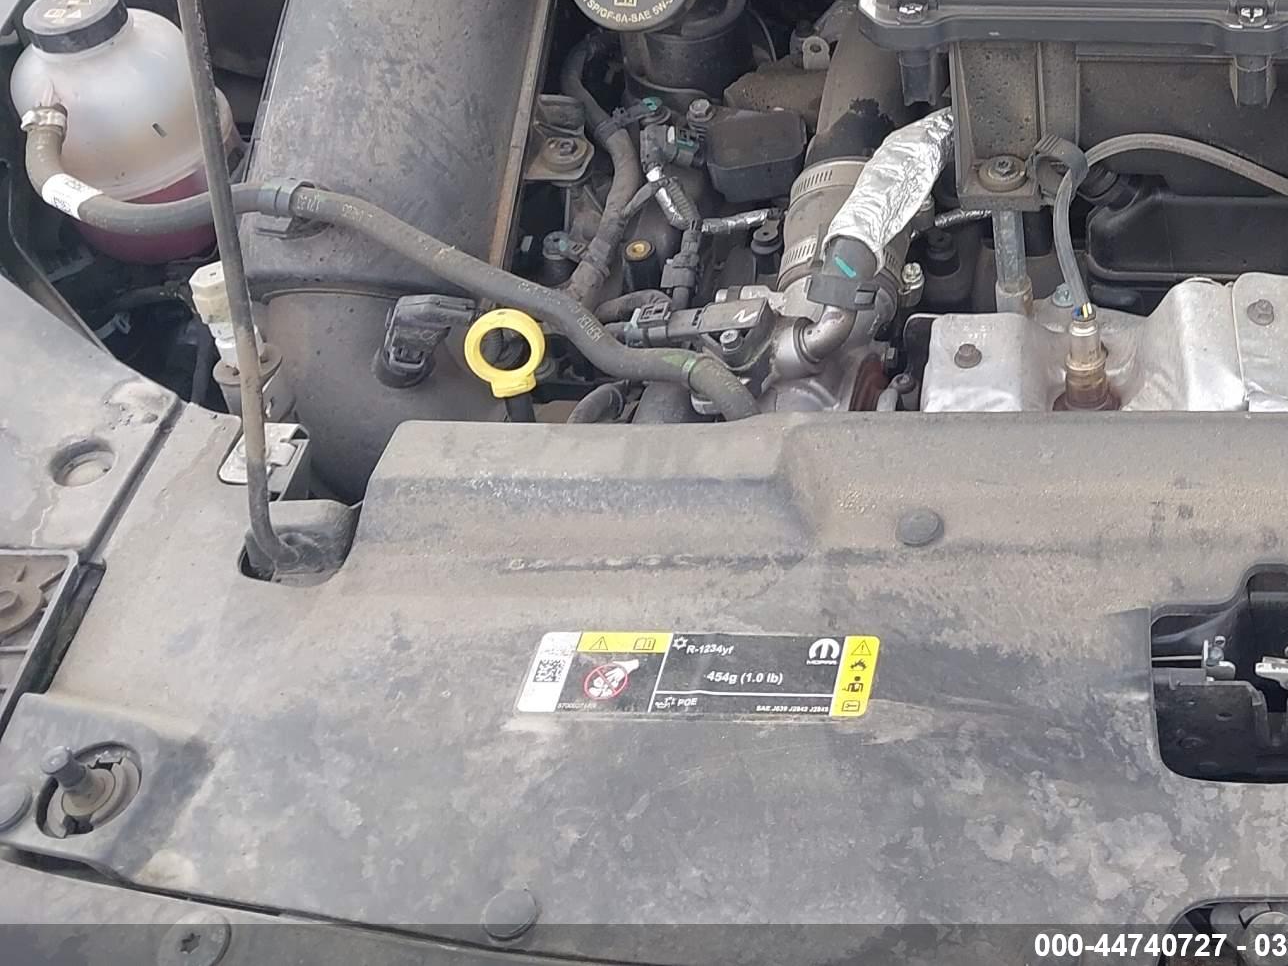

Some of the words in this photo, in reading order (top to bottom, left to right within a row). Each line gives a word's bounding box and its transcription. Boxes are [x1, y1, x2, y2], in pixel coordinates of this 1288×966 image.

[686, 644, 734, 656] R-1234yf
[706, 670, 738, 685] 454g
[740, 672, 764, 685] (1.0
[766, 673, 784, 685] lb)
[677, 697, 698, 707] POE
